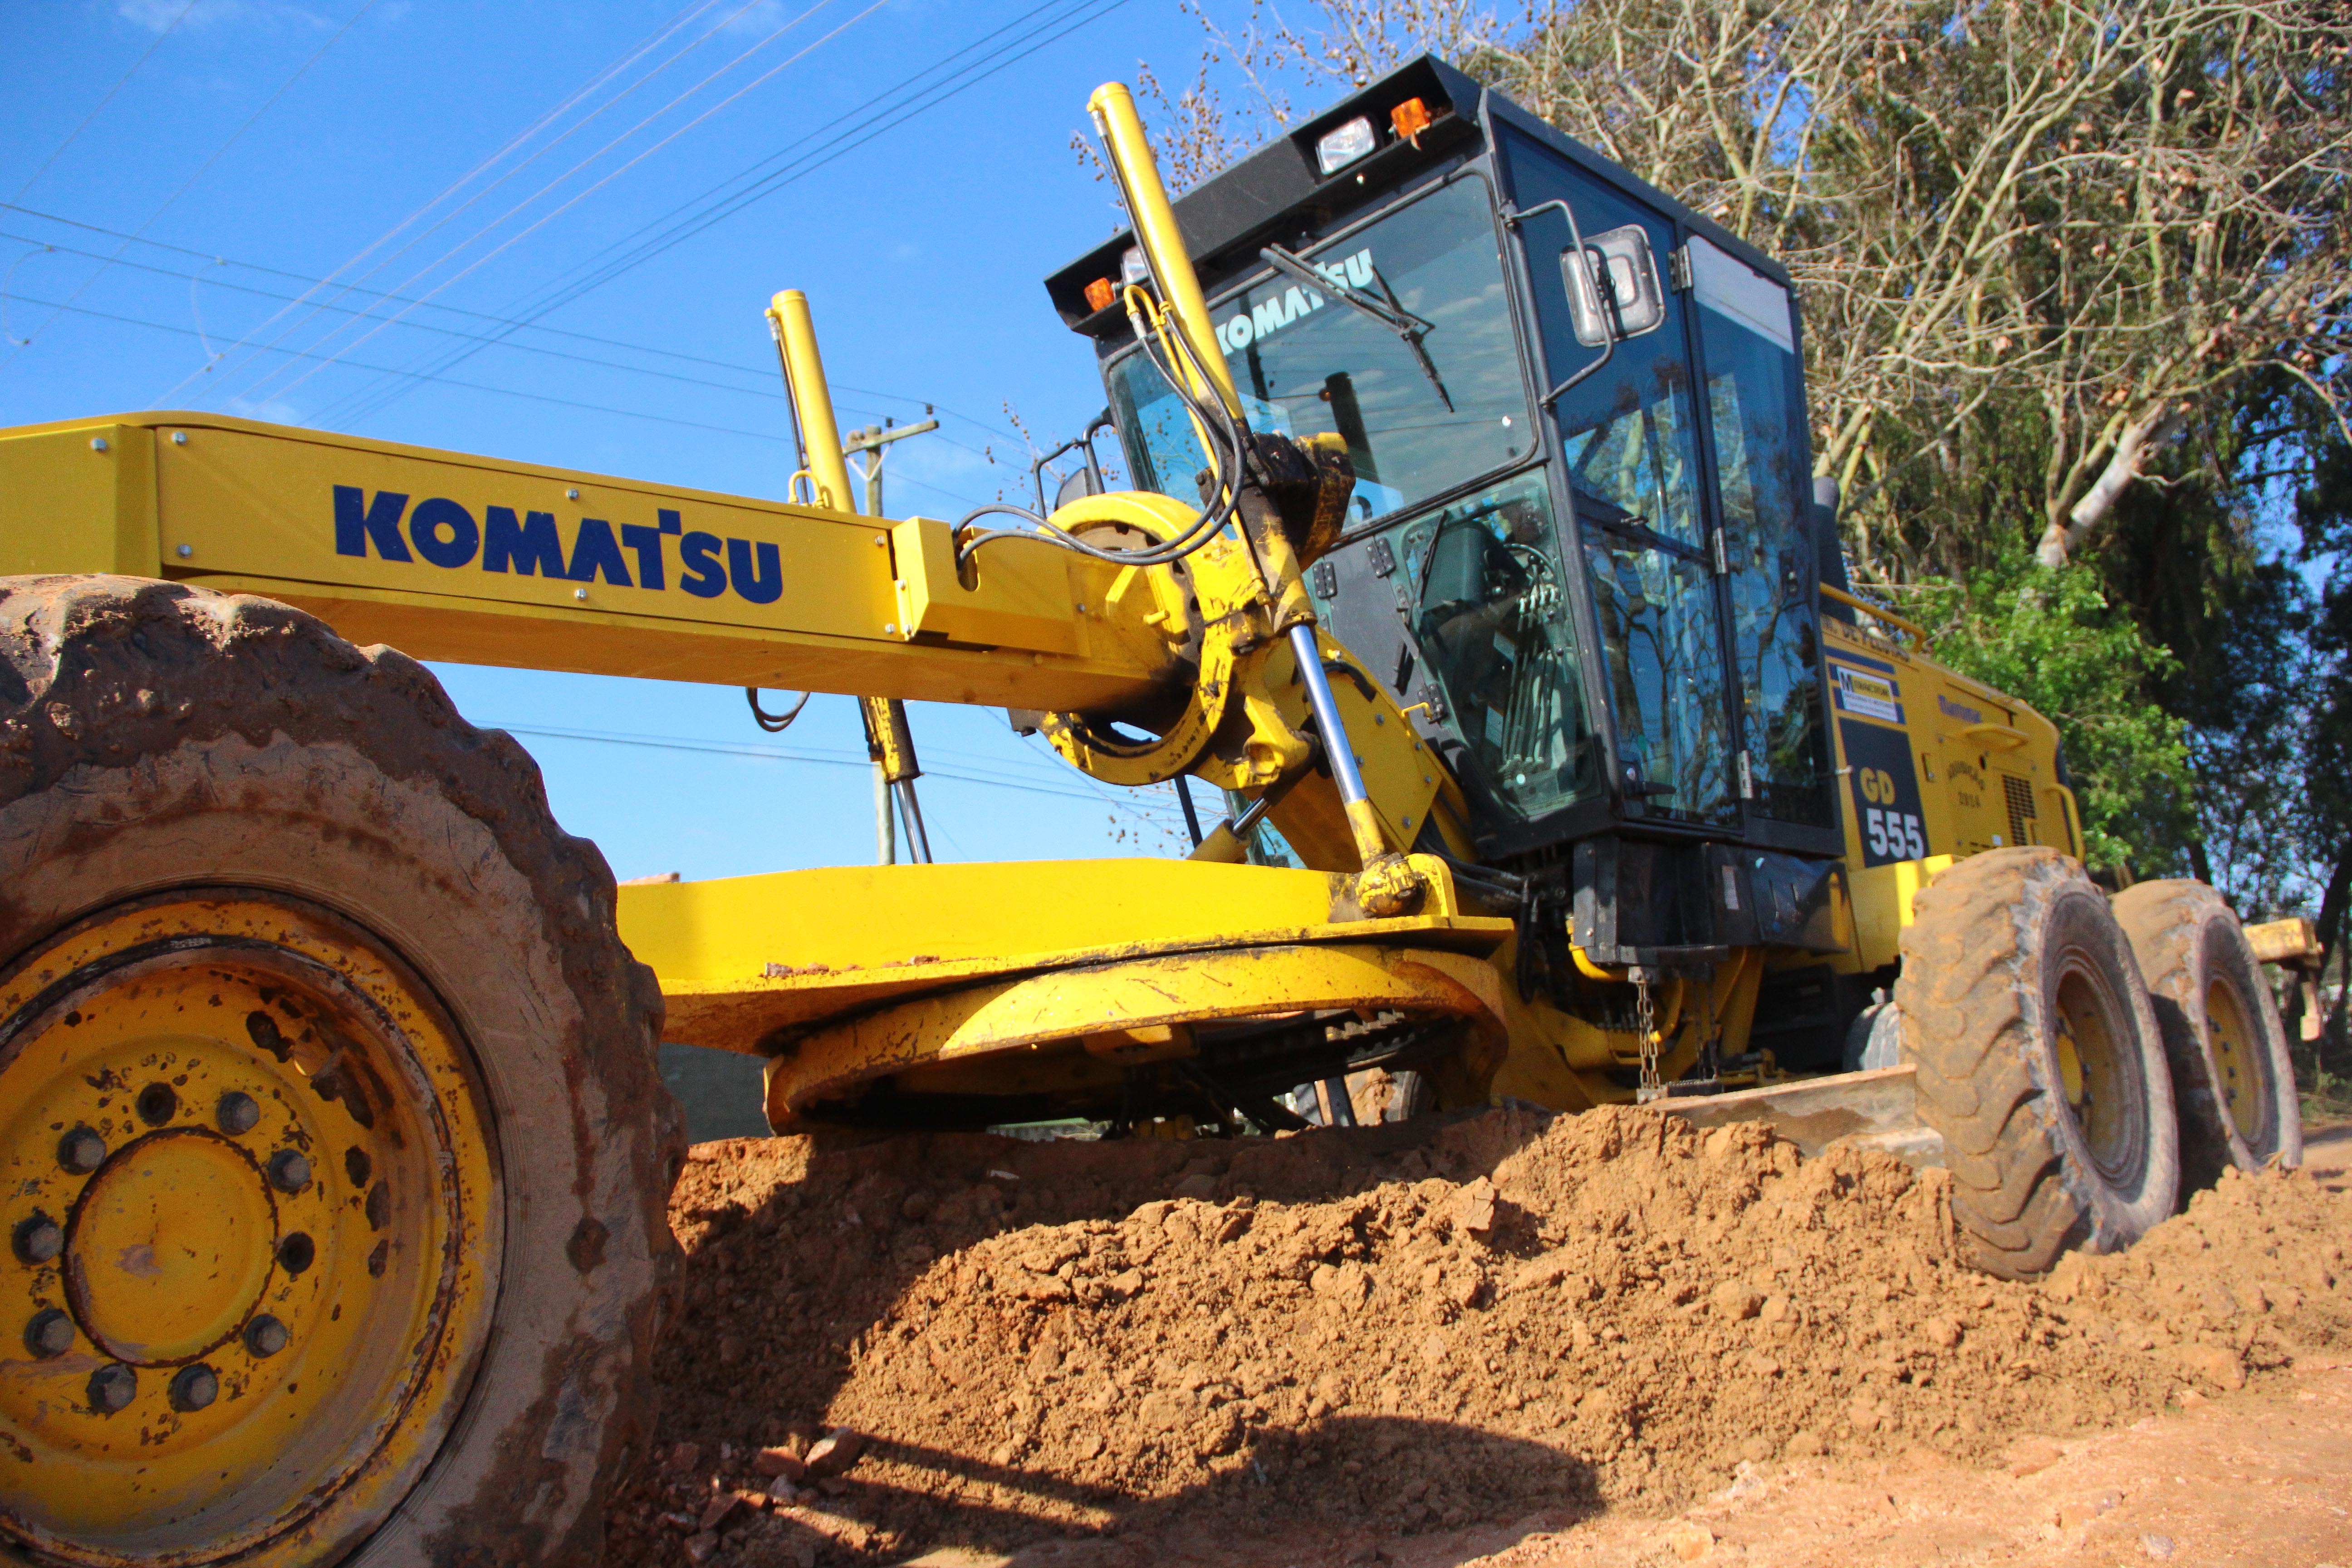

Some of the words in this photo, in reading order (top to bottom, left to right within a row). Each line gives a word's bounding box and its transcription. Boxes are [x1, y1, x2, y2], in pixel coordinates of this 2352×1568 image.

[333, 484, 784, 604] KOMATSU
[1860, 767, 1896, 805] GD
[1866, 808, 1925, 861] 555
